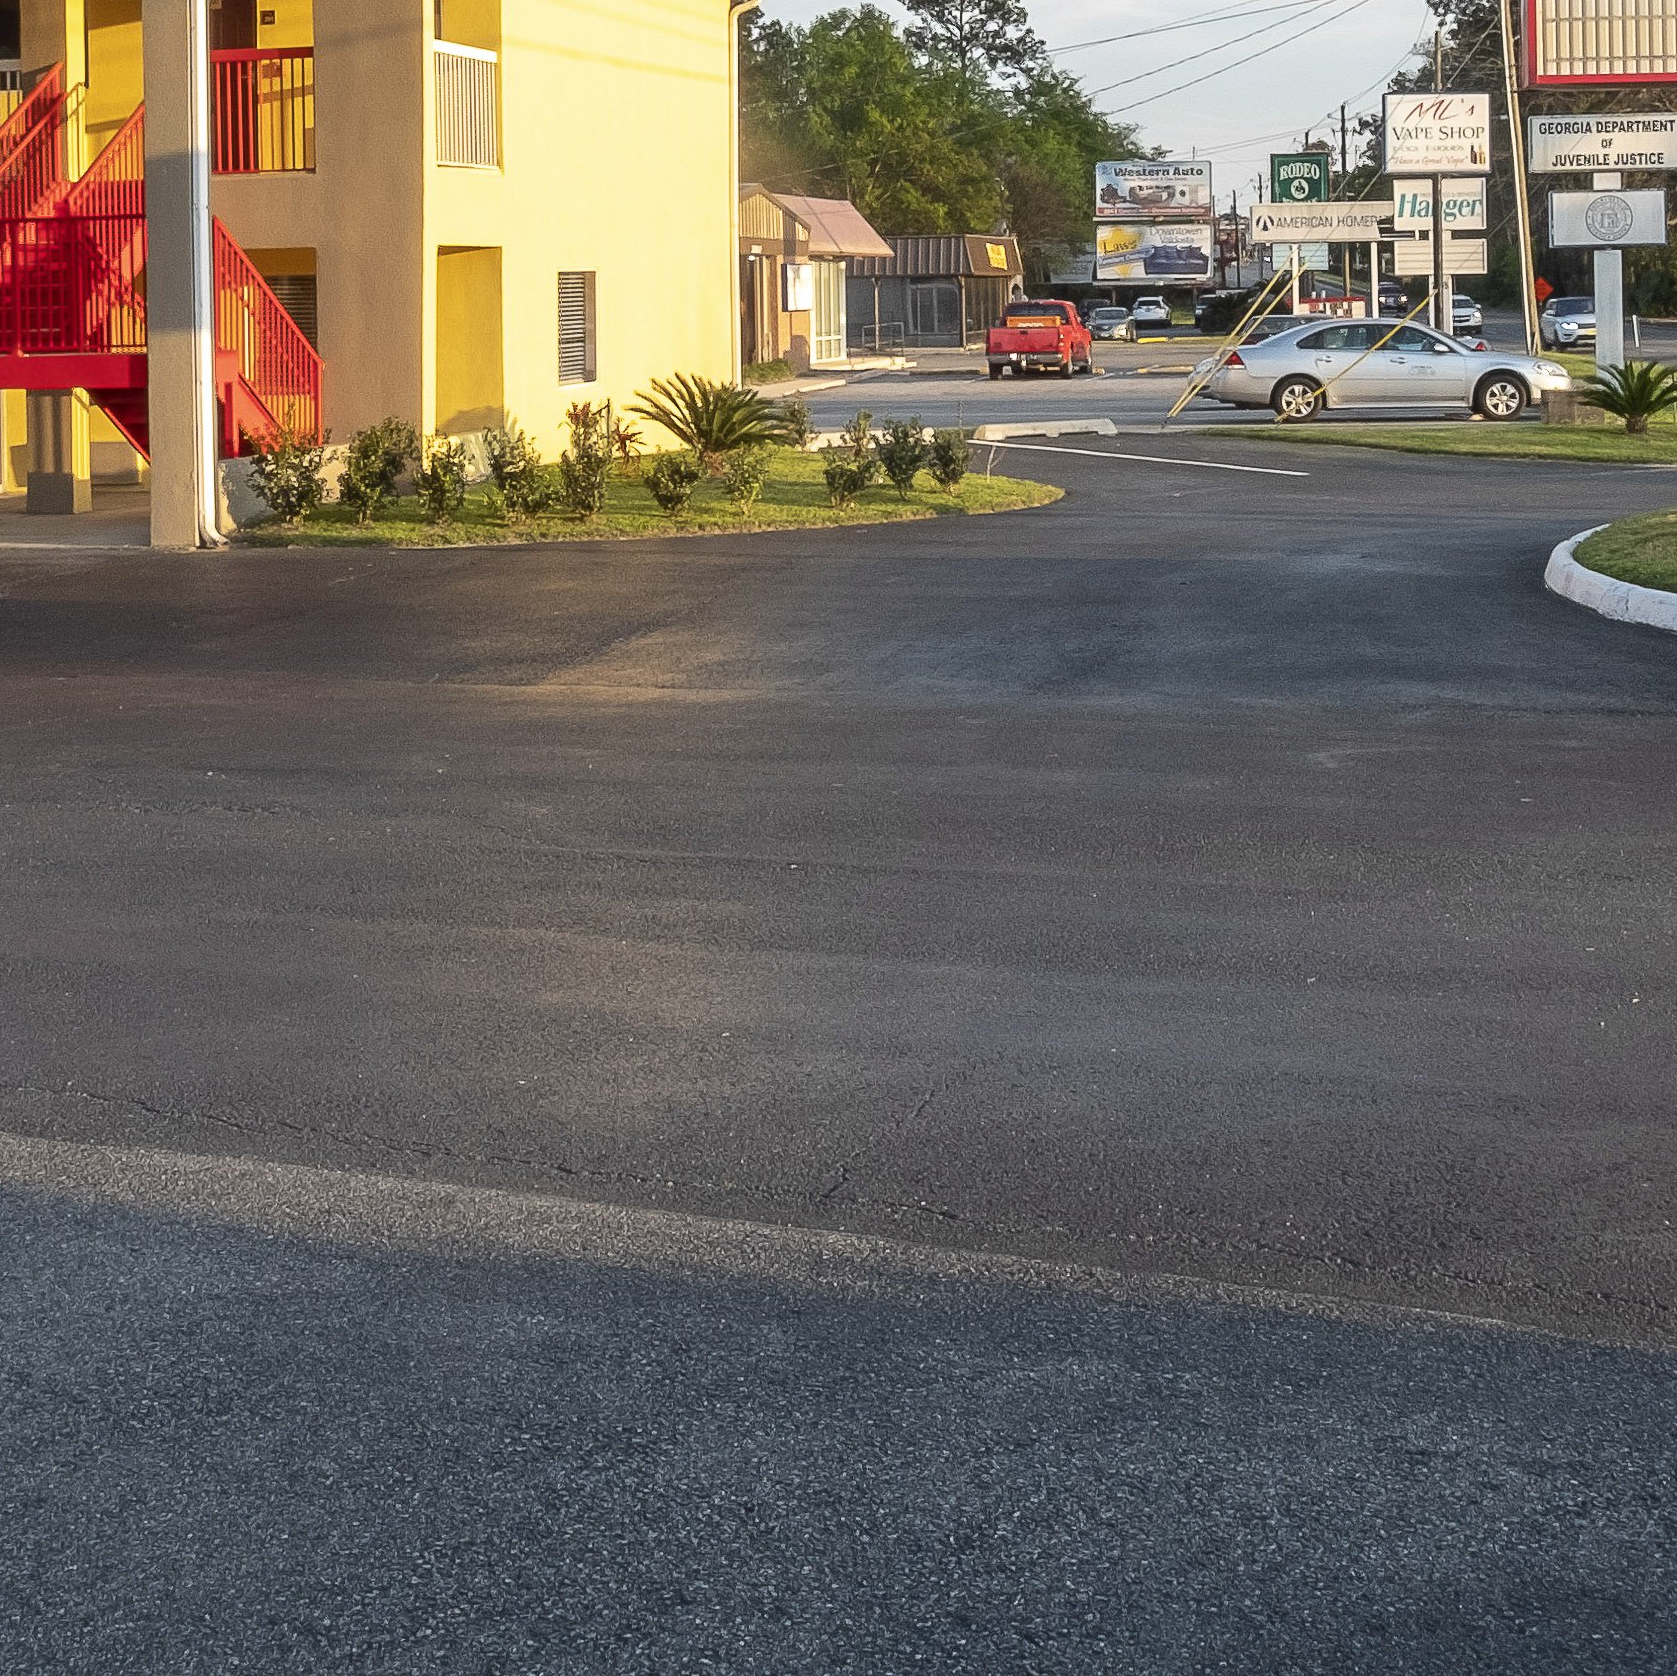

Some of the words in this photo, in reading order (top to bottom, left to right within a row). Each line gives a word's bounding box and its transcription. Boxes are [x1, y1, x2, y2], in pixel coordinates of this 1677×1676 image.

[1392, 126, 1433, 141] VAPE
[1439, 125, 1485, 140] SHOP
[1539, 122, 1592, 134] GEORGIA
[1596, 120, 1676, 133] DEPARTMENT
[1552, 154, 1610, 167] JUVENILE
[1614, 152, 1665, 166] JUSTICE
[1114, 167, 1170, 177] Western
[1173, 167, 1204, 176] Auto
[1279, 162, 1320, 180] RODEO
[1397, 193, 1482, 222] Hager
[1276, 215, 1333, 228] AMERICAN
[1337, 215, 1384, 228] HOMEP
